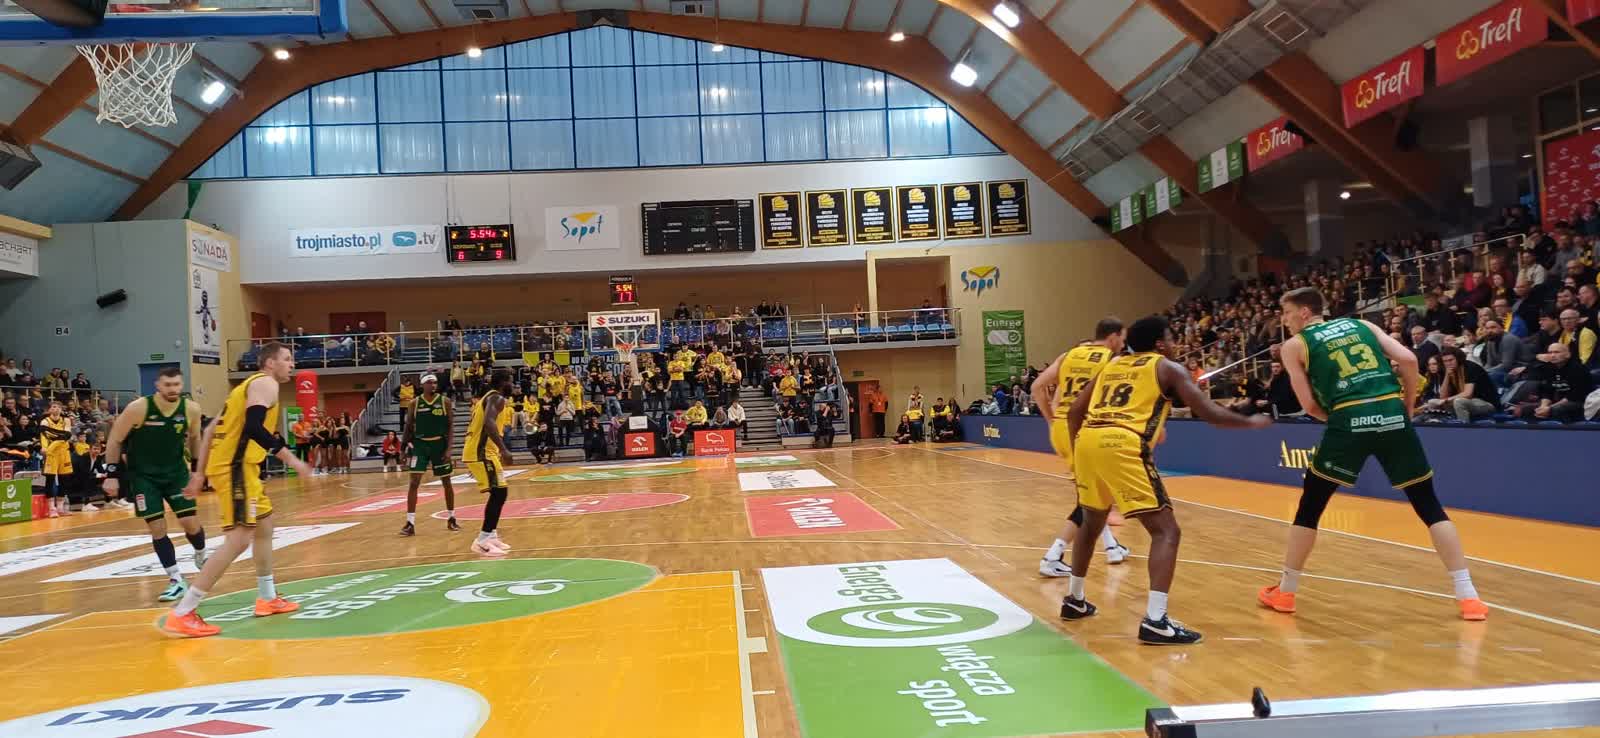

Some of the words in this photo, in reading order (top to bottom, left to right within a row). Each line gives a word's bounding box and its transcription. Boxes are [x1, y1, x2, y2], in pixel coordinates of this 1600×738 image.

[1479, 7, 1522, 49] Trefl
[1373, 60, 1412, 101] Trefl
[296, 232, 381, 251] trojmiasto.pl
[561, 213, 603, 243] Sopot
[458, 250, 465, 260] 6
[619, 291, 632, 302] 17
[960, 266, 1000, 297] Sopot
[608, 315, 650, 325] SUZUKI
[986, 318, 1022, 328] Energa
[1328, 343, 1379, 378] 13
[1094, 382, 1135, 409] 18
[1351, 414, 1384, 427] BRICO
[785, 506, 847, 529] ORLEN
[288, 571, 481, 619] Energa
[838, 565, 904, 602] Energa
[936, 644, 1016, 696] włącza
[45, 688, 411, 727] SUZUKI
[896, 680, 989, 727] sport
